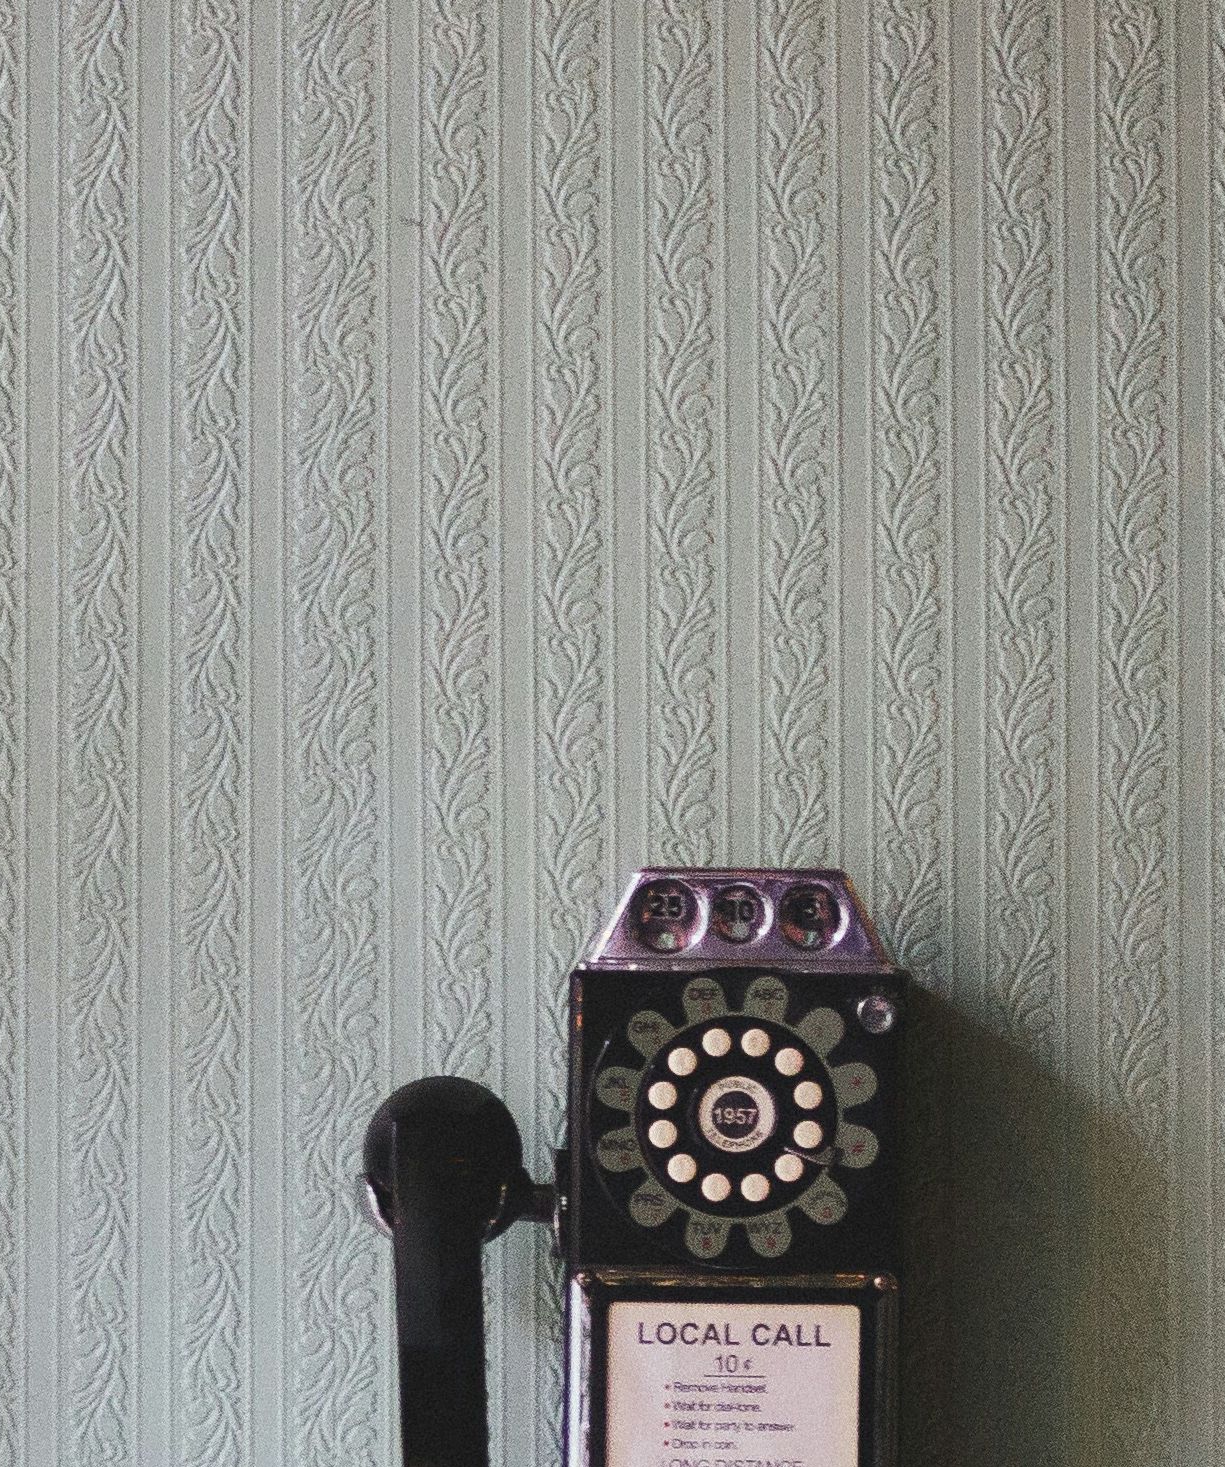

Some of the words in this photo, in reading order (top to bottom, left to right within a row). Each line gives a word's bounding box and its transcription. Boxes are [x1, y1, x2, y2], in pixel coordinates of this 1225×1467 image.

[650, 894, 683, 919] 25
[726, 898, 756, 923] 10
[714, 1108, 757, 1125] 1957
[637, 1322, 740, 1346] LOCAL
[751, 1323, 832, 1348] CALL
[673, 1381, 719, 1394] Remove
[672, 1419, 697, 1431] Wait
[698, 1420, 712, 1431] for
[743, 1421, 756, 1431] to
[671, 1438, 699, 1451] Drop
